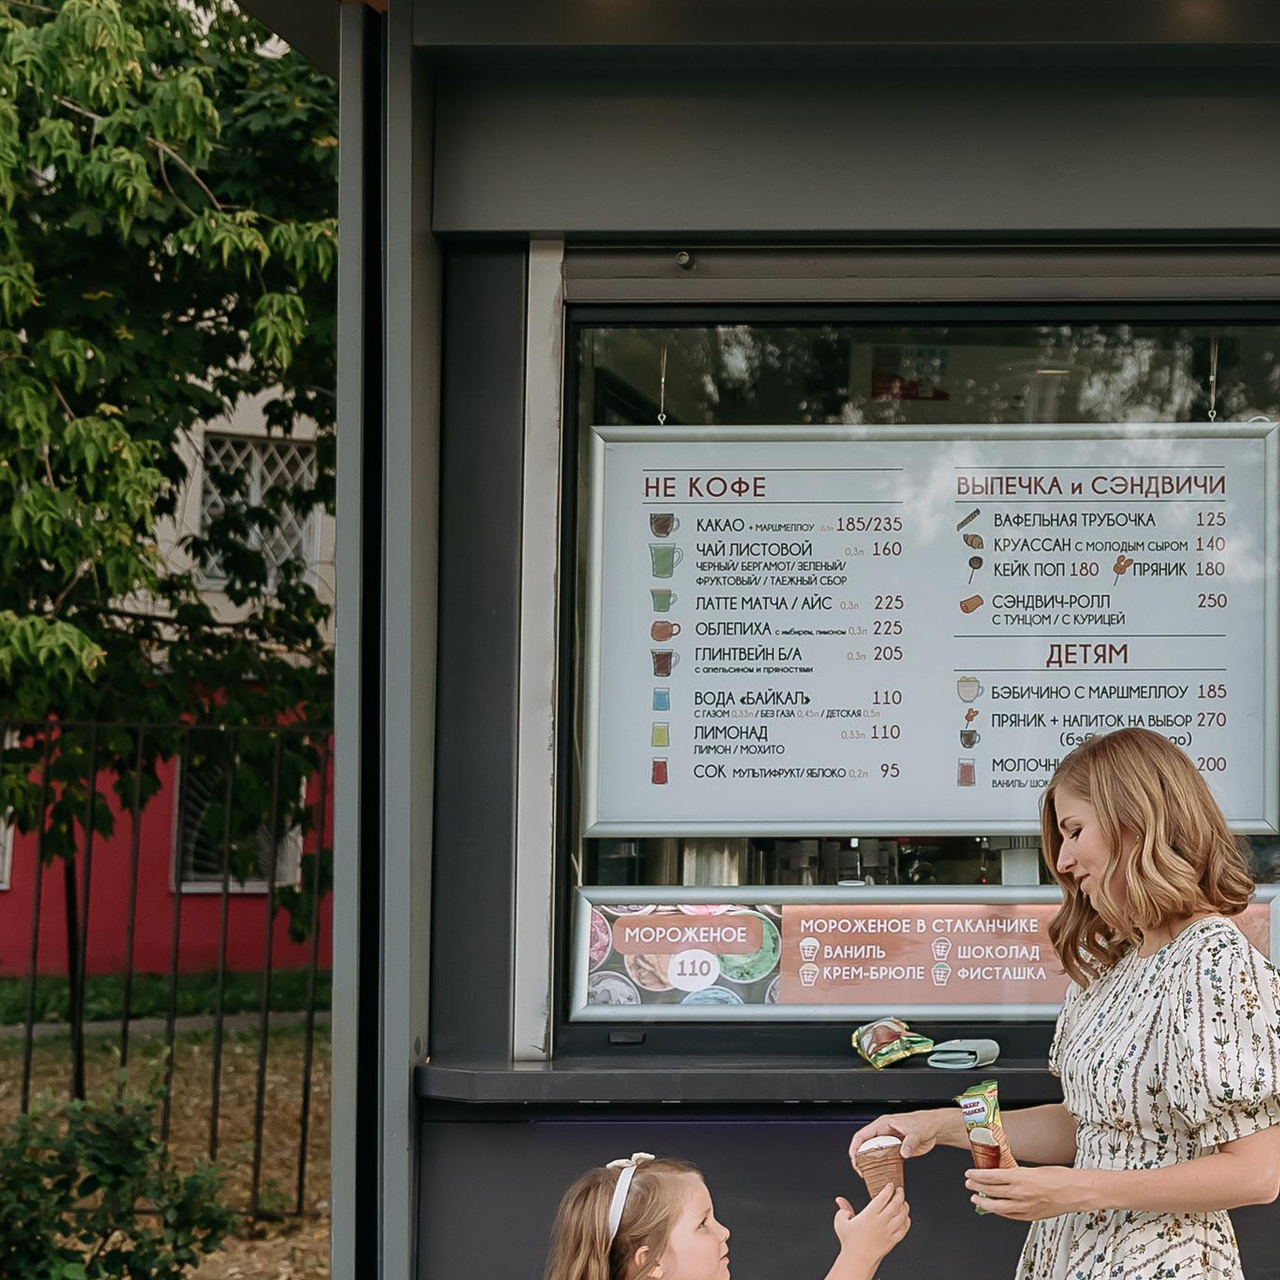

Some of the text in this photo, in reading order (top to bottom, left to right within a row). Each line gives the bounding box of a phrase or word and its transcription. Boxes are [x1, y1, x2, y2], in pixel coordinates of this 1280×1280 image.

[644, 477, 766, 498] НЕ КОФЕ
[956, 475, 1226, 498] ВЫПЕЧКА и СЭНДВИЧИ
[696, 517, 903, 532] КАКАО МАРШМЕЛЛОУ 185/235
[994, 512, 1226, 527] ВАФЕЛЬНАЯ ТРУБОЧКА 125
[696, 540, 726, 556] ЧАЙ
[729, 540, 812, 556] ЛИСТОВОЙ
[872, 541, 902, 556] 160
[994, 538, 1071, 552] КРУАССАН
[1086, 542, 1144, 554] МОЛОДЫМ
[1147, 542, 1188, 552] СЫРОМ
[1196, 537, 1225, 552] 140
[741, 562, 796, 571] БЕРГАМОТ/
[994, 560, 1225, 576] КЕЙК ПОП 180 ПРЯНИК 180
[770, 574, 848, 586] ТАЕЖНЫЙ СБОР
[696, 596, 737, 610] ЛАТТЕ
[741, 596, 788, 610] МАТЧА
[801, 594, 832, 610] АЙС
[874, 595, 904, 610] 225
[992, 594, 1227, 610] СЭНДВИЧ-РОЛЛ 250
[992, 612, 1125, 626] С ТУНЦОМ С КУРИЦЕЙ
[696, 622, 772, 636] ОБЛЕПИХА
[873, 620, 903, 635] 225
[695, 645, 774, 661] ГЛИНТВЕЙН
[778, 647, 802, 661] Б/А
[874, 646, 903, 661] 205
[1046, 644, 1128, 668] ДЕТЯМ
[702, 666, 754, 674] апельсином
[763, 666, 813, 674] пряностями
[694, 688, 902, 707] ВОДА «БАЙКАЛ» 110
[992, 685, 1227, 699] БЭБИЧИНО С МАРШМЕЛЛОУ 185
[694, 710, 700, 718] С
[702, 710, 730, 718] ГАЗОМ
[776, 710, 795, 718] ГАЗА
[826, 710, 862, 719] ДЕТСКАЯ
[992, 714, 1046, 728] ПРЯНИК
[1063, 714, 1125, 727] НАПИТОК
[1128, 714, 1145, 727] НА
[1148, 714, 1192, 727] ВЫБОР
[1197, 712, 1227, 727] 270
[694, 726, 768, 742] ЛИМОНАД
[870, 725, 900, 739] 110
[694, 745, 785, 754] ЛИМОН МОХИТО
[694, 765, 726, 778] СОК
[806, 768, 846, 778] ЯБЛОКО
[880, 764, 900, 778] 95
[992, 757, 1227, 772] МОЛОЧН 200
[800, 918, 1038, 933] МОРОЖЕНОЕ В СТАКАНЧИКЕ
[624, 926, 746, 942] МОРОЖЕНОЕ
[824, 946, 1040, 961] ВАНИЛЬ ШОКОЛАД
[677, 960, 710, 976] 110
[823, 966, 1046, 980] КРЕМ-БРЮЛЕ ФИСТАШКА
